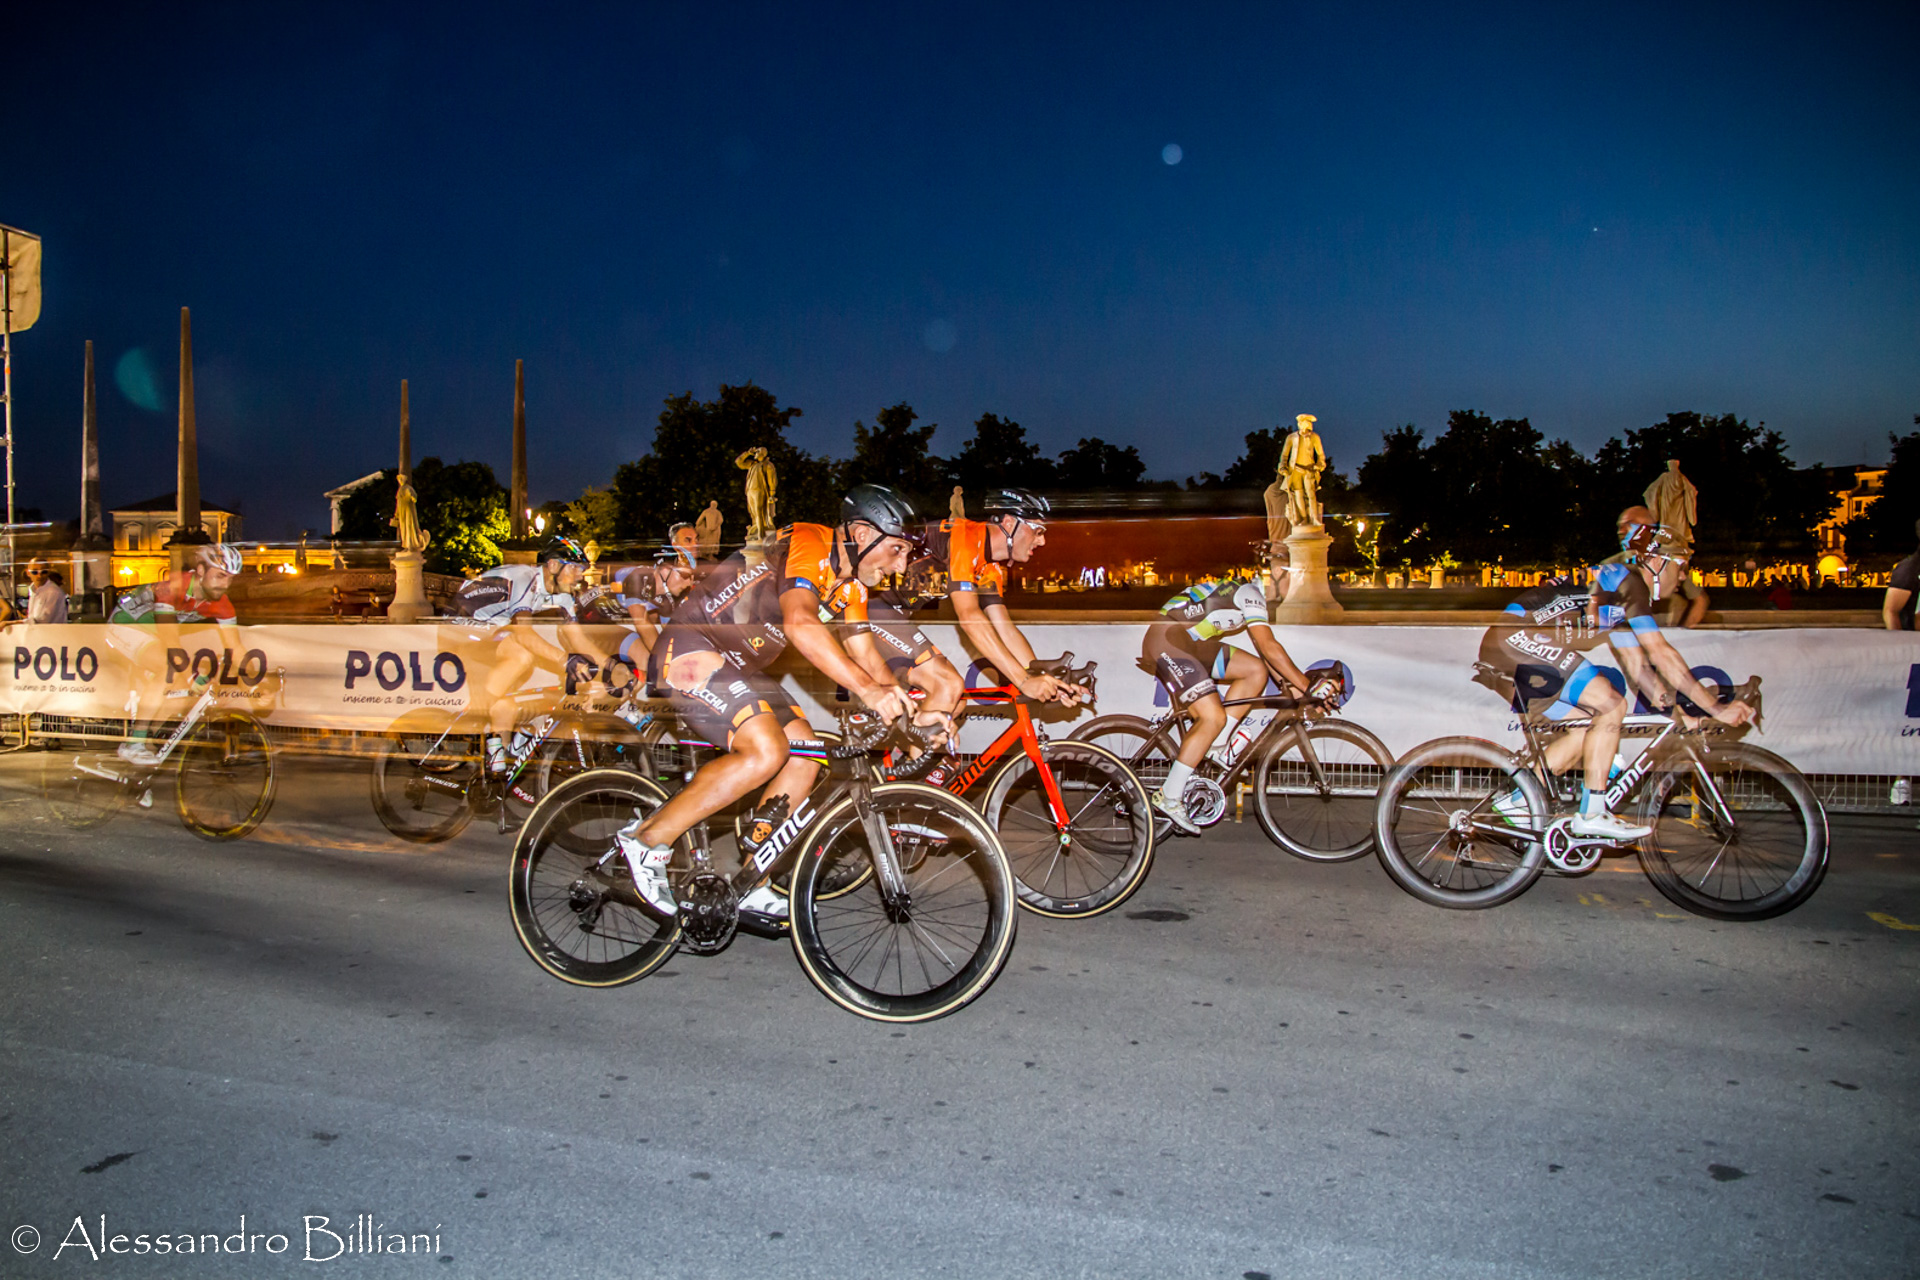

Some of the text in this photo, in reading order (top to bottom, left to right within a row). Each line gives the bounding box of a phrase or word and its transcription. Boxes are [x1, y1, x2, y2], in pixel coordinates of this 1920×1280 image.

[705, 562, 769, 613] CARTURAN
[1534, 599, 1576, 623] MELATO
[14, 646, 98, 682] POLO
[1507, 630, 1563, 662] BRIGATO
[165, 647, 267, 687] POLO
[344, 650, 467, 693] POLO
[342, 693, 383, 705] insieme
[424, 698, 465, 706] cucina
[1605, 752, 1653, 810] BMC
[753, 797, 816, 874] BMC
[879, 853, 893, 882] BMC
